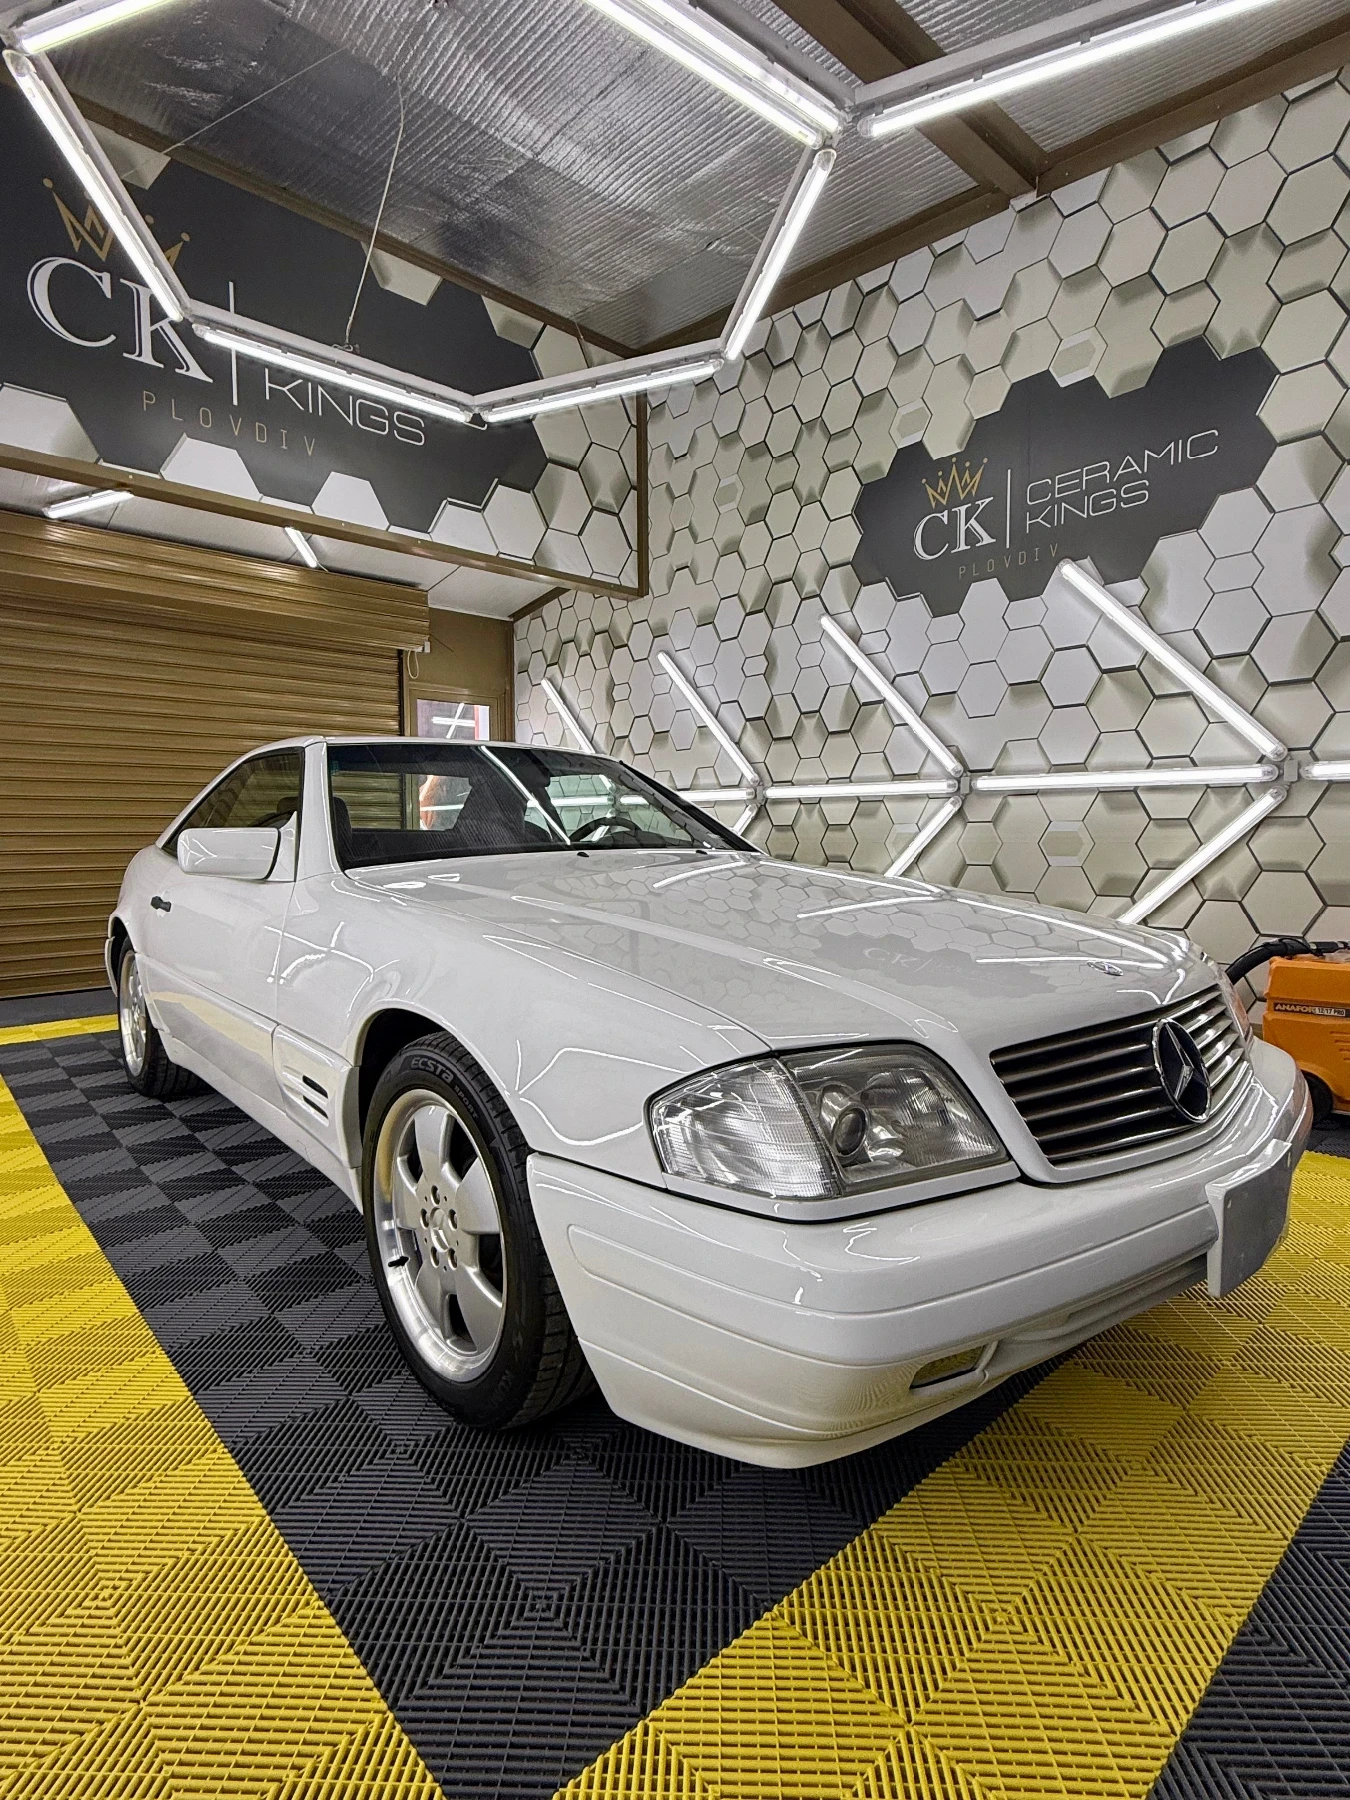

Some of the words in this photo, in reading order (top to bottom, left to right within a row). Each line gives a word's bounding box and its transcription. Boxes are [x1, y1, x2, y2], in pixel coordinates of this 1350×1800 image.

[26, 256, 213, 383] CK
[142, 390, 316, 456] PLOVDIV
[264, 368, 426, 445] KINGS
[1026, 429, 1219, 507] CERAMIC
[913, 496, 996, 561] CK
[1026, 479, 1149, 533] KINGS
[958, 542, 1060, 580] PLOVDIV
